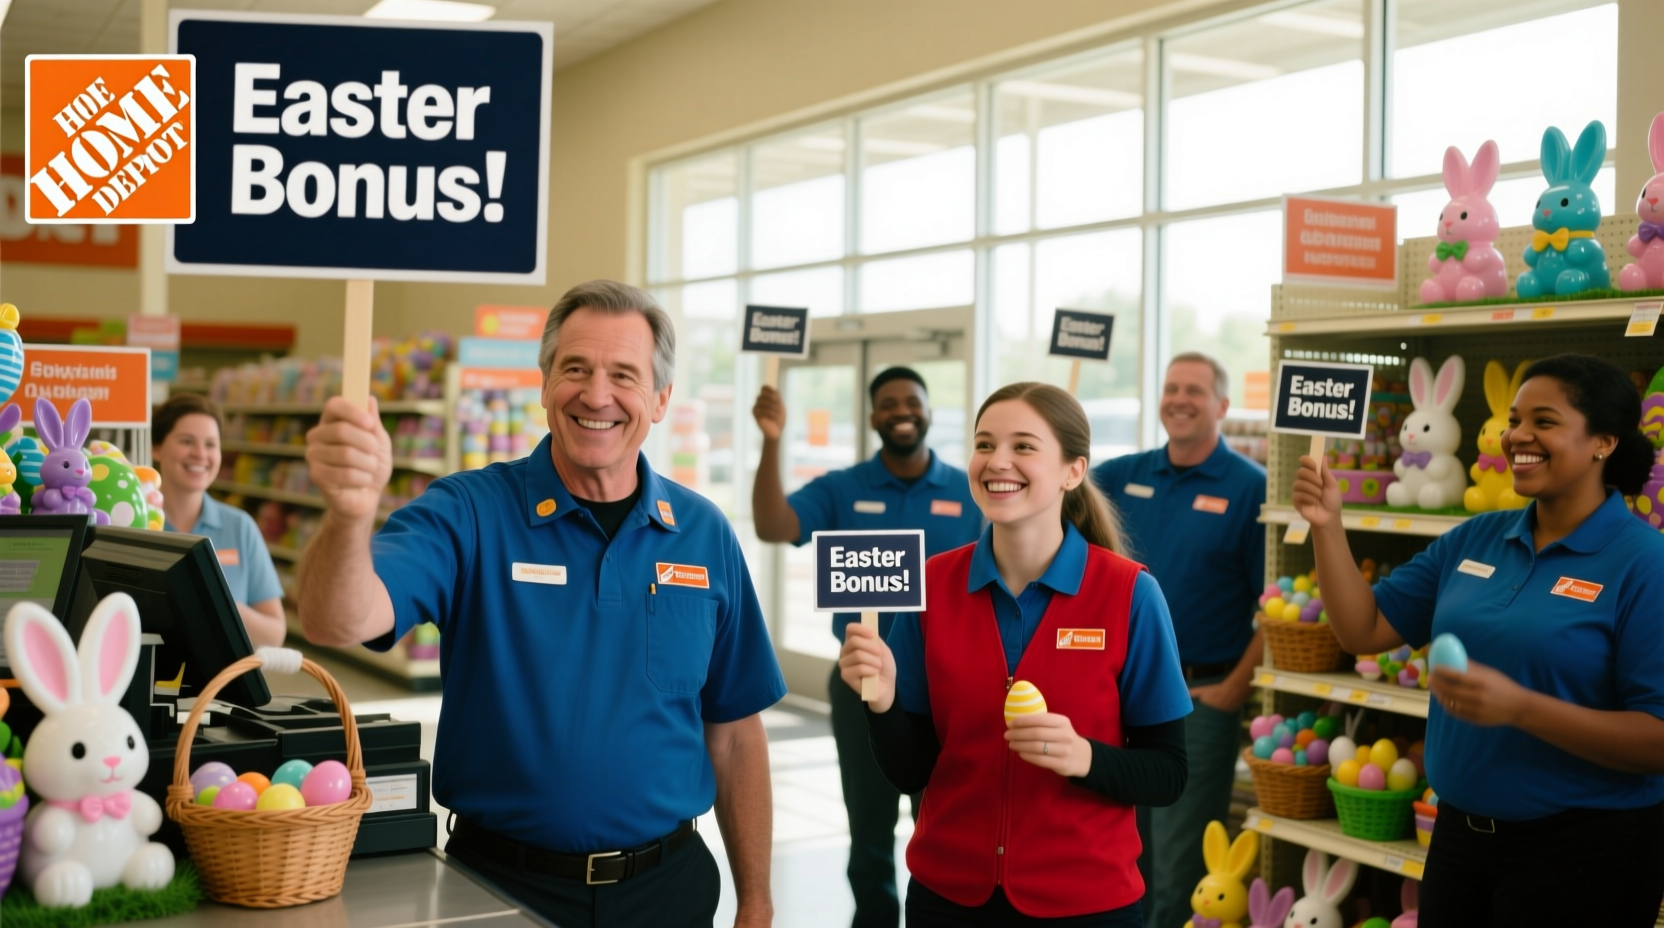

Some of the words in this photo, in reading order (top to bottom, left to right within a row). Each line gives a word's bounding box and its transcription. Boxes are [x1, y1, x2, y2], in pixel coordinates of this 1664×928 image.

[233, 62, 491, 141] Easter
[231, 144, 507, 223] Bonus!
[1289, 374, 1355, 398] Easter
[1287, 396, 1356, 421] Bonus!
[830, 546, 906, 568] Easter
[830, 569, 910, 593] Bonus!
